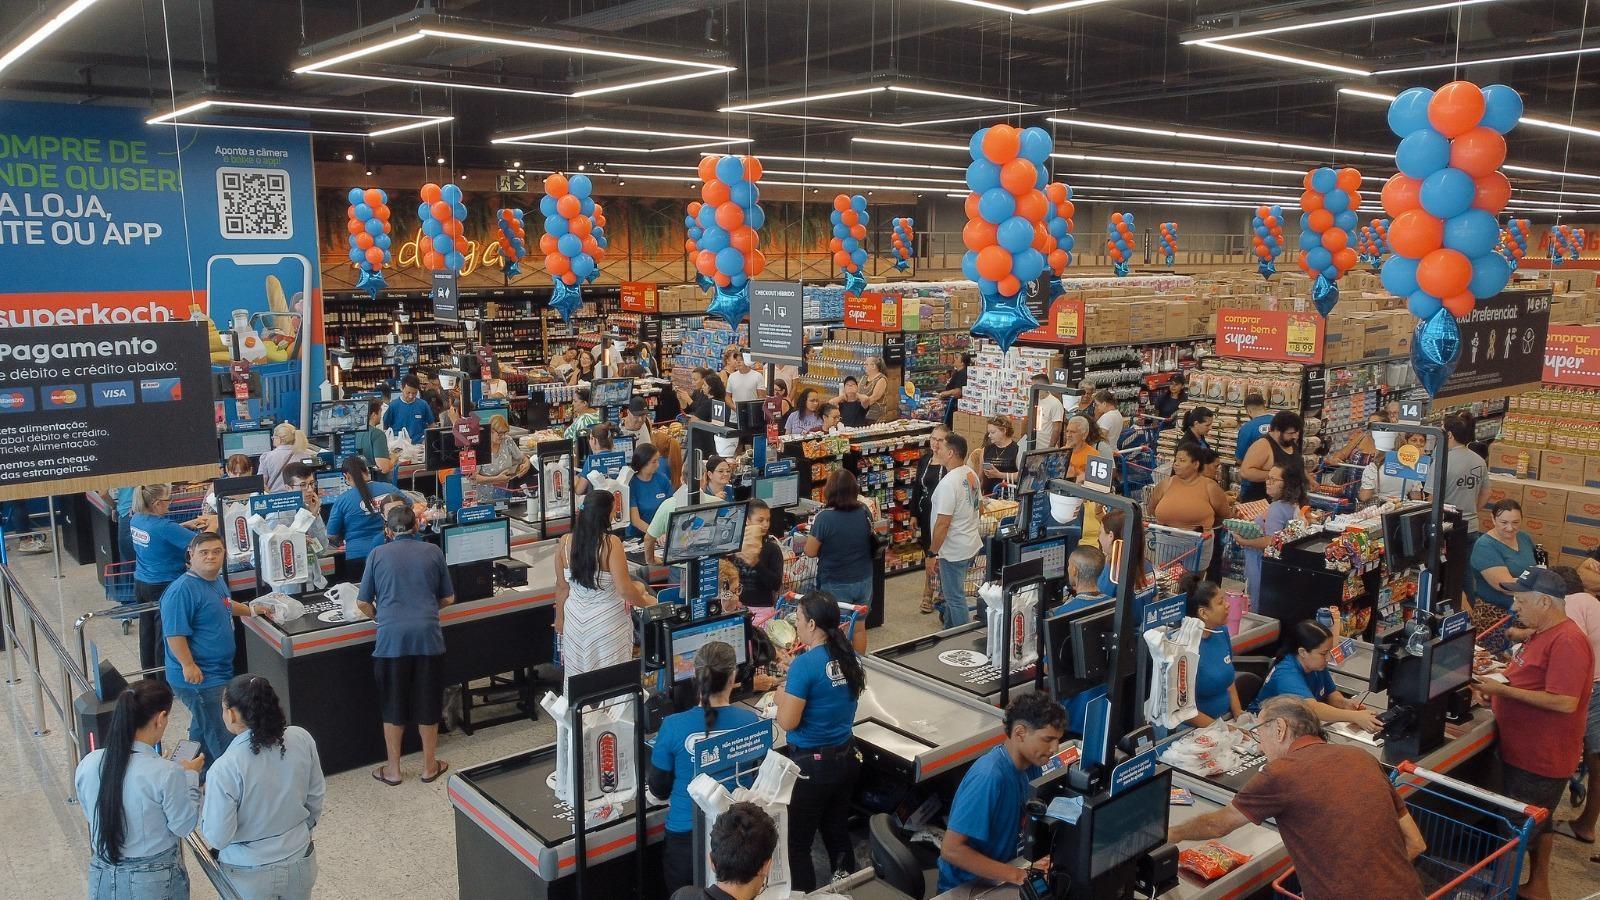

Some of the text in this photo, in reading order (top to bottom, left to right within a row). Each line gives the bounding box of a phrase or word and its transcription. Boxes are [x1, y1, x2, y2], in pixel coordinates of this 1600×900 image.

[108, 140, 148, 164] DE
[215, 146, 247, 156] Aponte
[257, 148, 288, 157] câmera
[25, 193, 112, 221] LOJA,
[52, 222, 95, 245] OU
[103, 223, 162, 245] APP
[849, 310, 867, 324] super
[1472, 305, 1519, 321] Preferencial
[1224, 315, 1261, 324] comprar
[1251, 325, 1270, 335] bem
[1224, 333, 1258, 352] super
[1546, 332, 1590, 343] omprar
[0, 337, 157, 363] Pagamento
[1295, 344, 1313, 352] 8.99
[10, 368, 57, 380] débito
[74, 364, 123, 376] crédito
[128, 361, 177, 373] abaixo:
[1055, 370, 1065, 380] 16
[1309, 371, 1317, 379] 02
[103, 389, 127, 398] VISA
[713, 404, 723, 416] 17
[1402, 405, 1418, 417] 14
[19, 421, 88, 433] alimentação:
[27, 431, 60, 442] débito
[72, 428, 110, 439] crédito.
[32, 439, 99, 452] Alimentação.
[38, 458, 54, 466] em
[57, 454, 98, 466] cheque.
[1, 464, 91, 480] das estrangeiras.
[1090, 460, 1108, 479] 15
